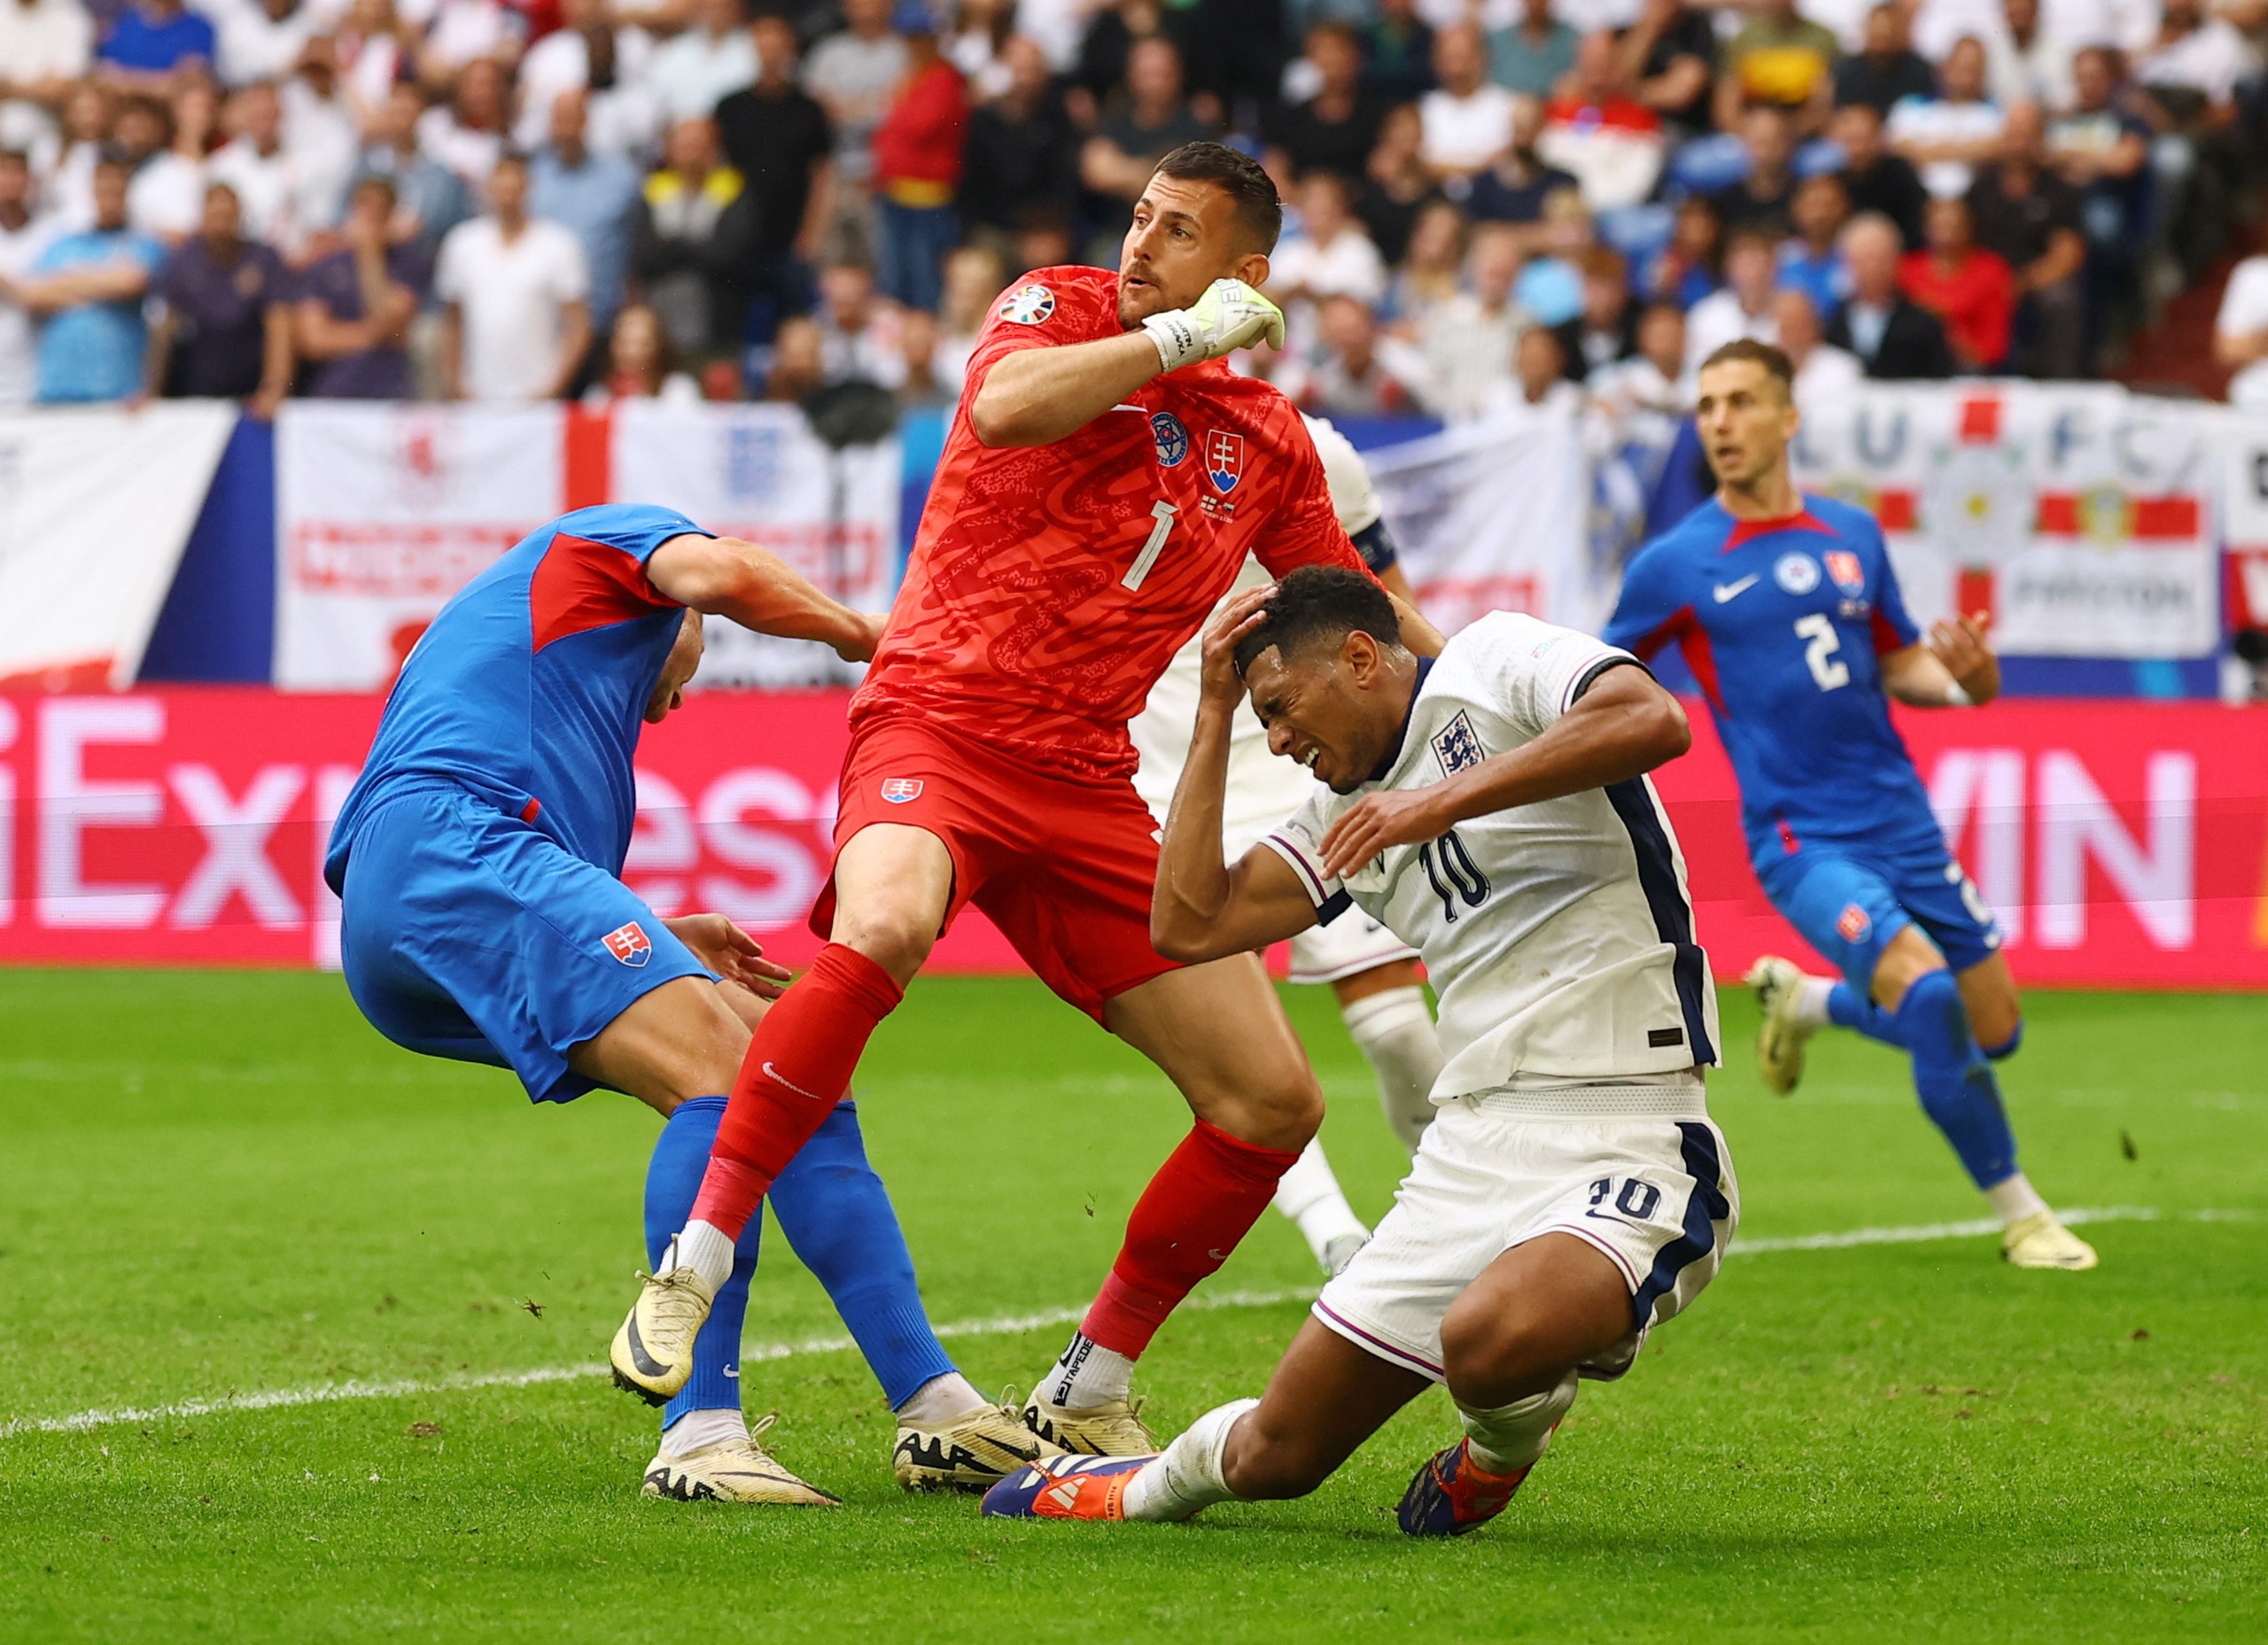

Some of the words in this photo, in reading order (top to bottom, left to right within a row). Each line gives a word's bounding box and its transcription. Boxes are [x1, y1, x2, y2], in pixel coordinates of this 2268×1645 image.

[1121, 500, 1179, 592] 1
[1793, 612, 1851, 693] 2
[0, 695, 842, 973] Exes
[1419, 830, 1491, 923] 10
[1588, 1176, 1661, 1222] 10
